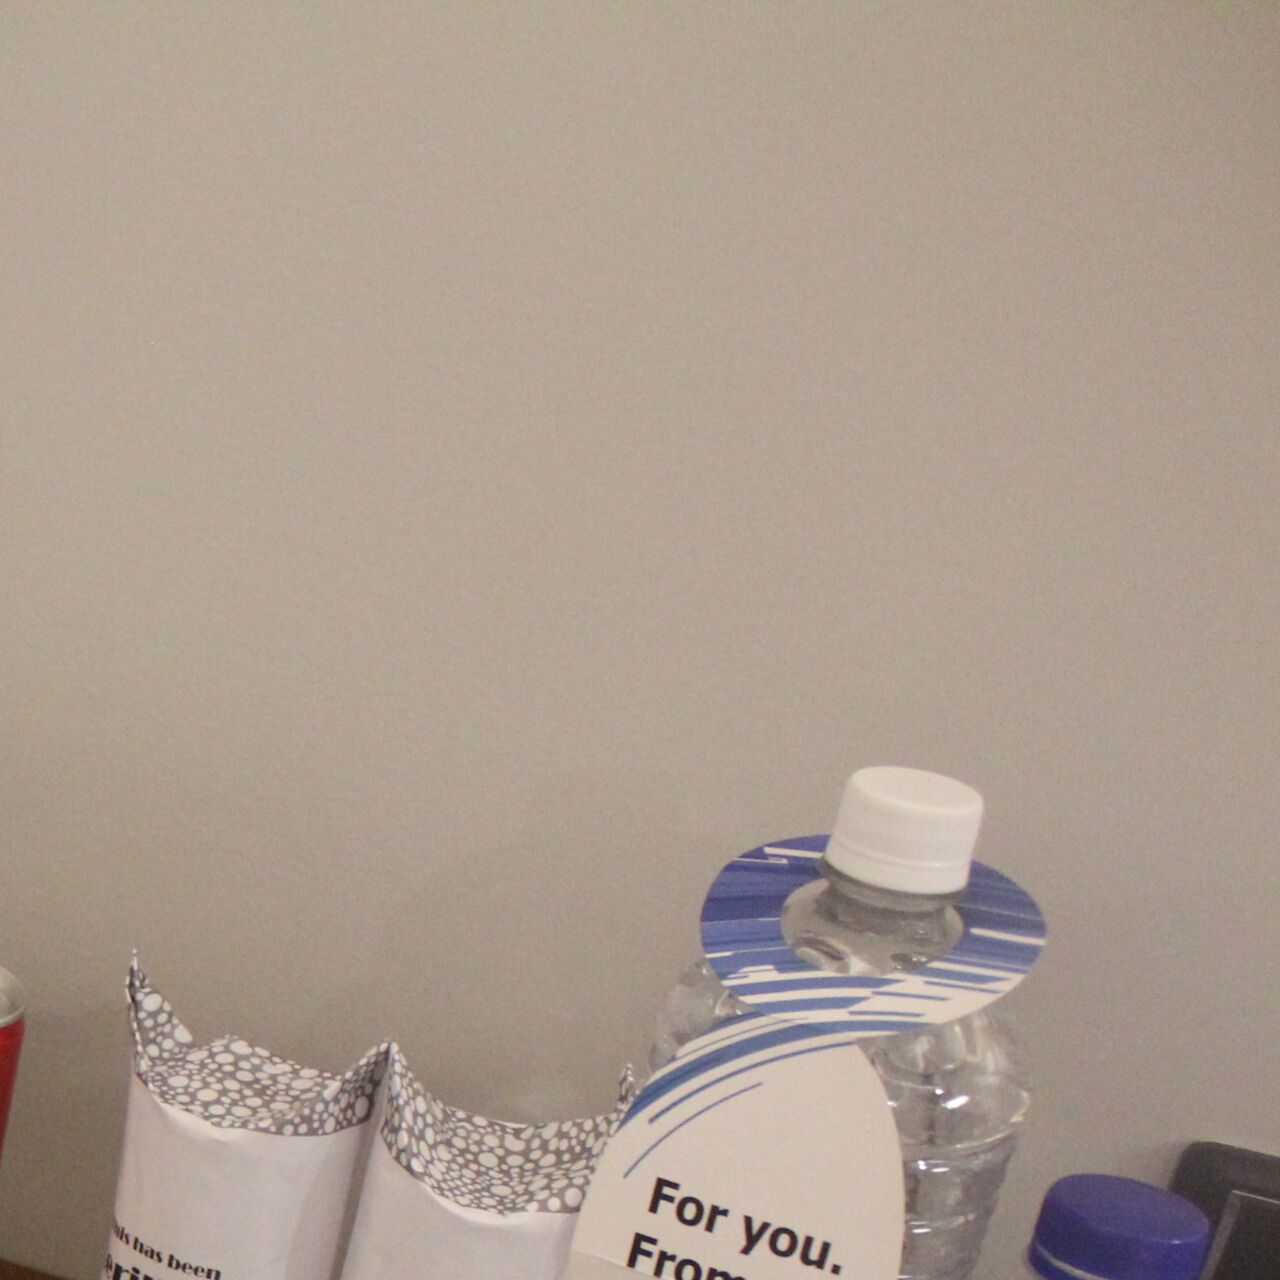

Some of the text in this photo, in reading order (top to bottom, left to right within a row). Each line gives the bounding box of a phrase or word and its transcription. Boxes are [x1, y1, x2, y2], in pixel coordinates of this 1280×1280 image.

[133, 1236, 163, 1264] has
[648, 1177, 842, 1276] For you.
